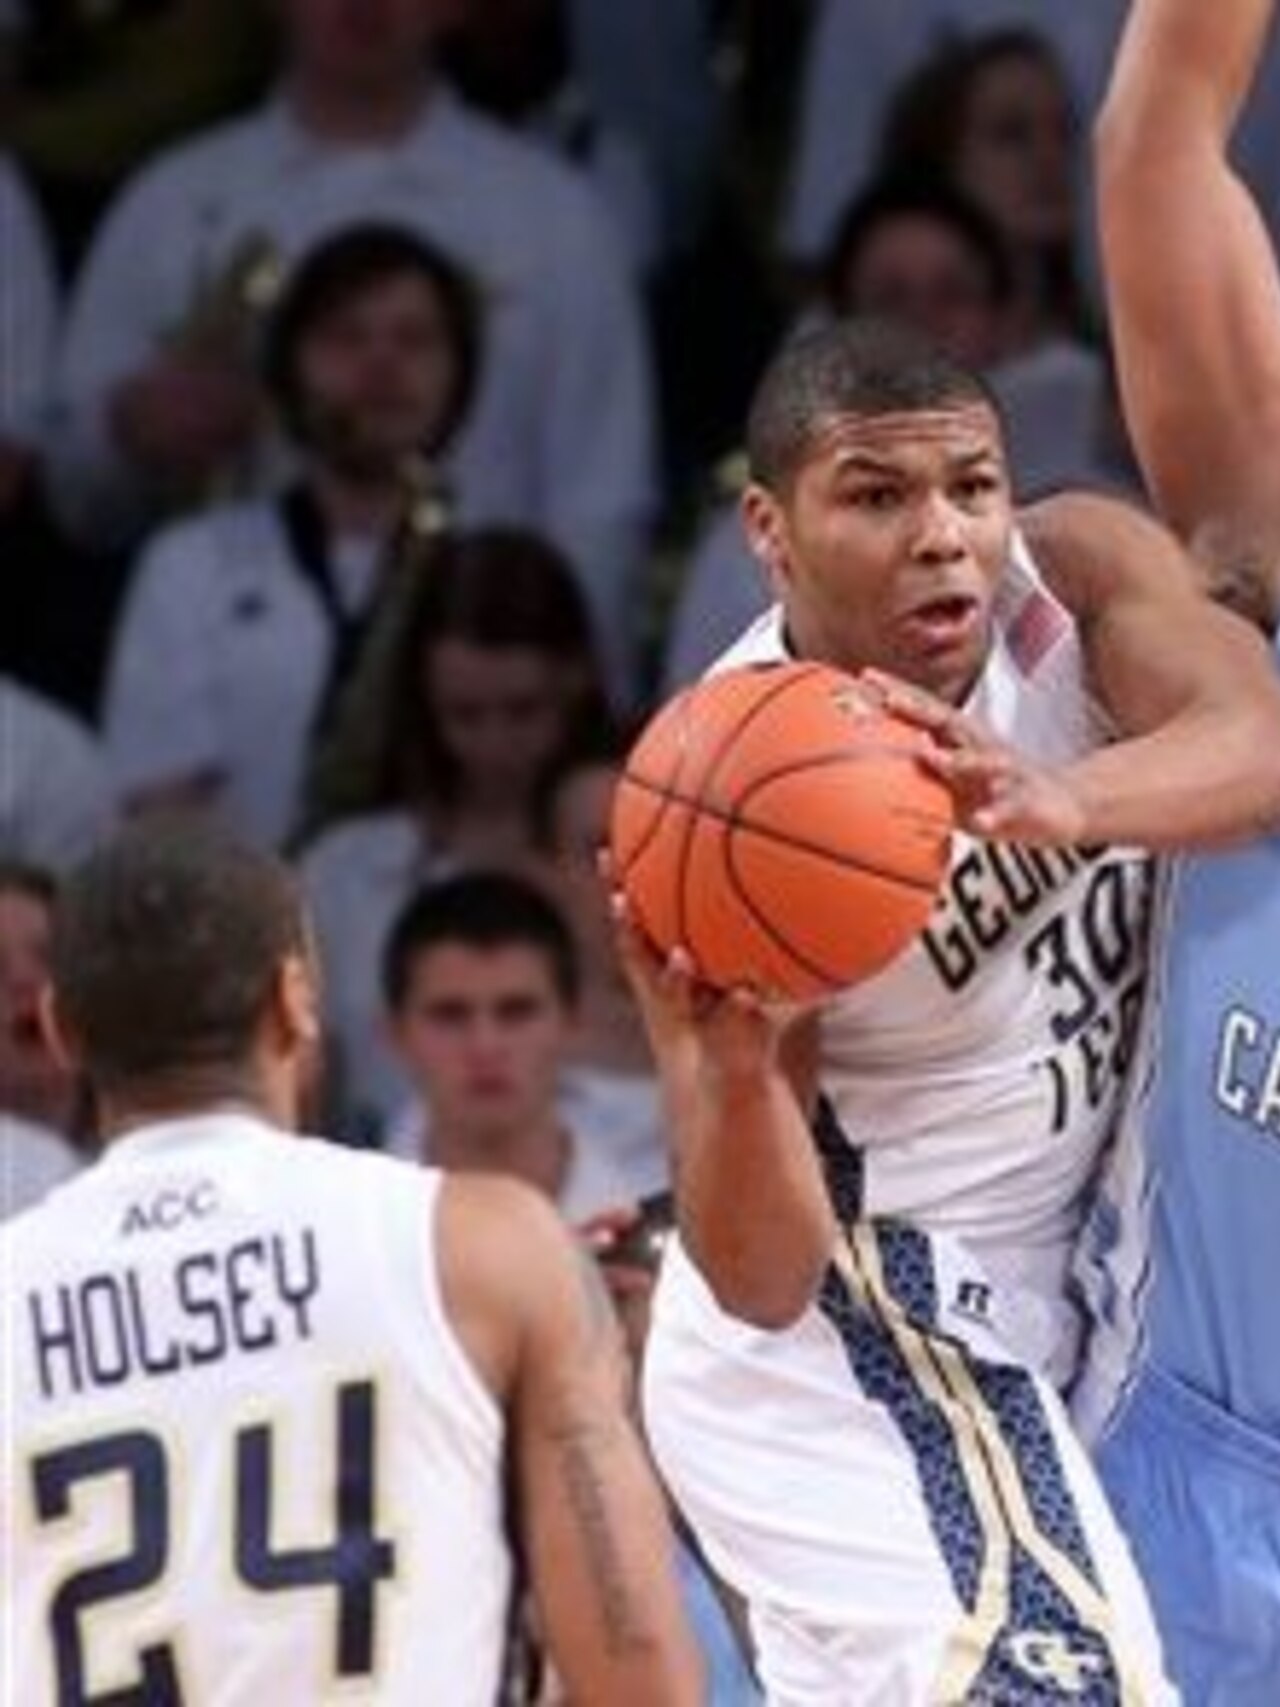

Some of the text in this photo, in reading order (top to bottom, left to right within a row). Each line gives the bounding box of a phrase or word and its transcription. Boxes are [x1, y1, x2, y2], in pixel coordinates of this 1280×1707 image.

[1025, 858, 1136, 1044] 30
[120, 1180, 221, 1238] ACC
[28, 1227, 320, 1401] HOLSEY
[30, 1378, 397, 1707] 24
